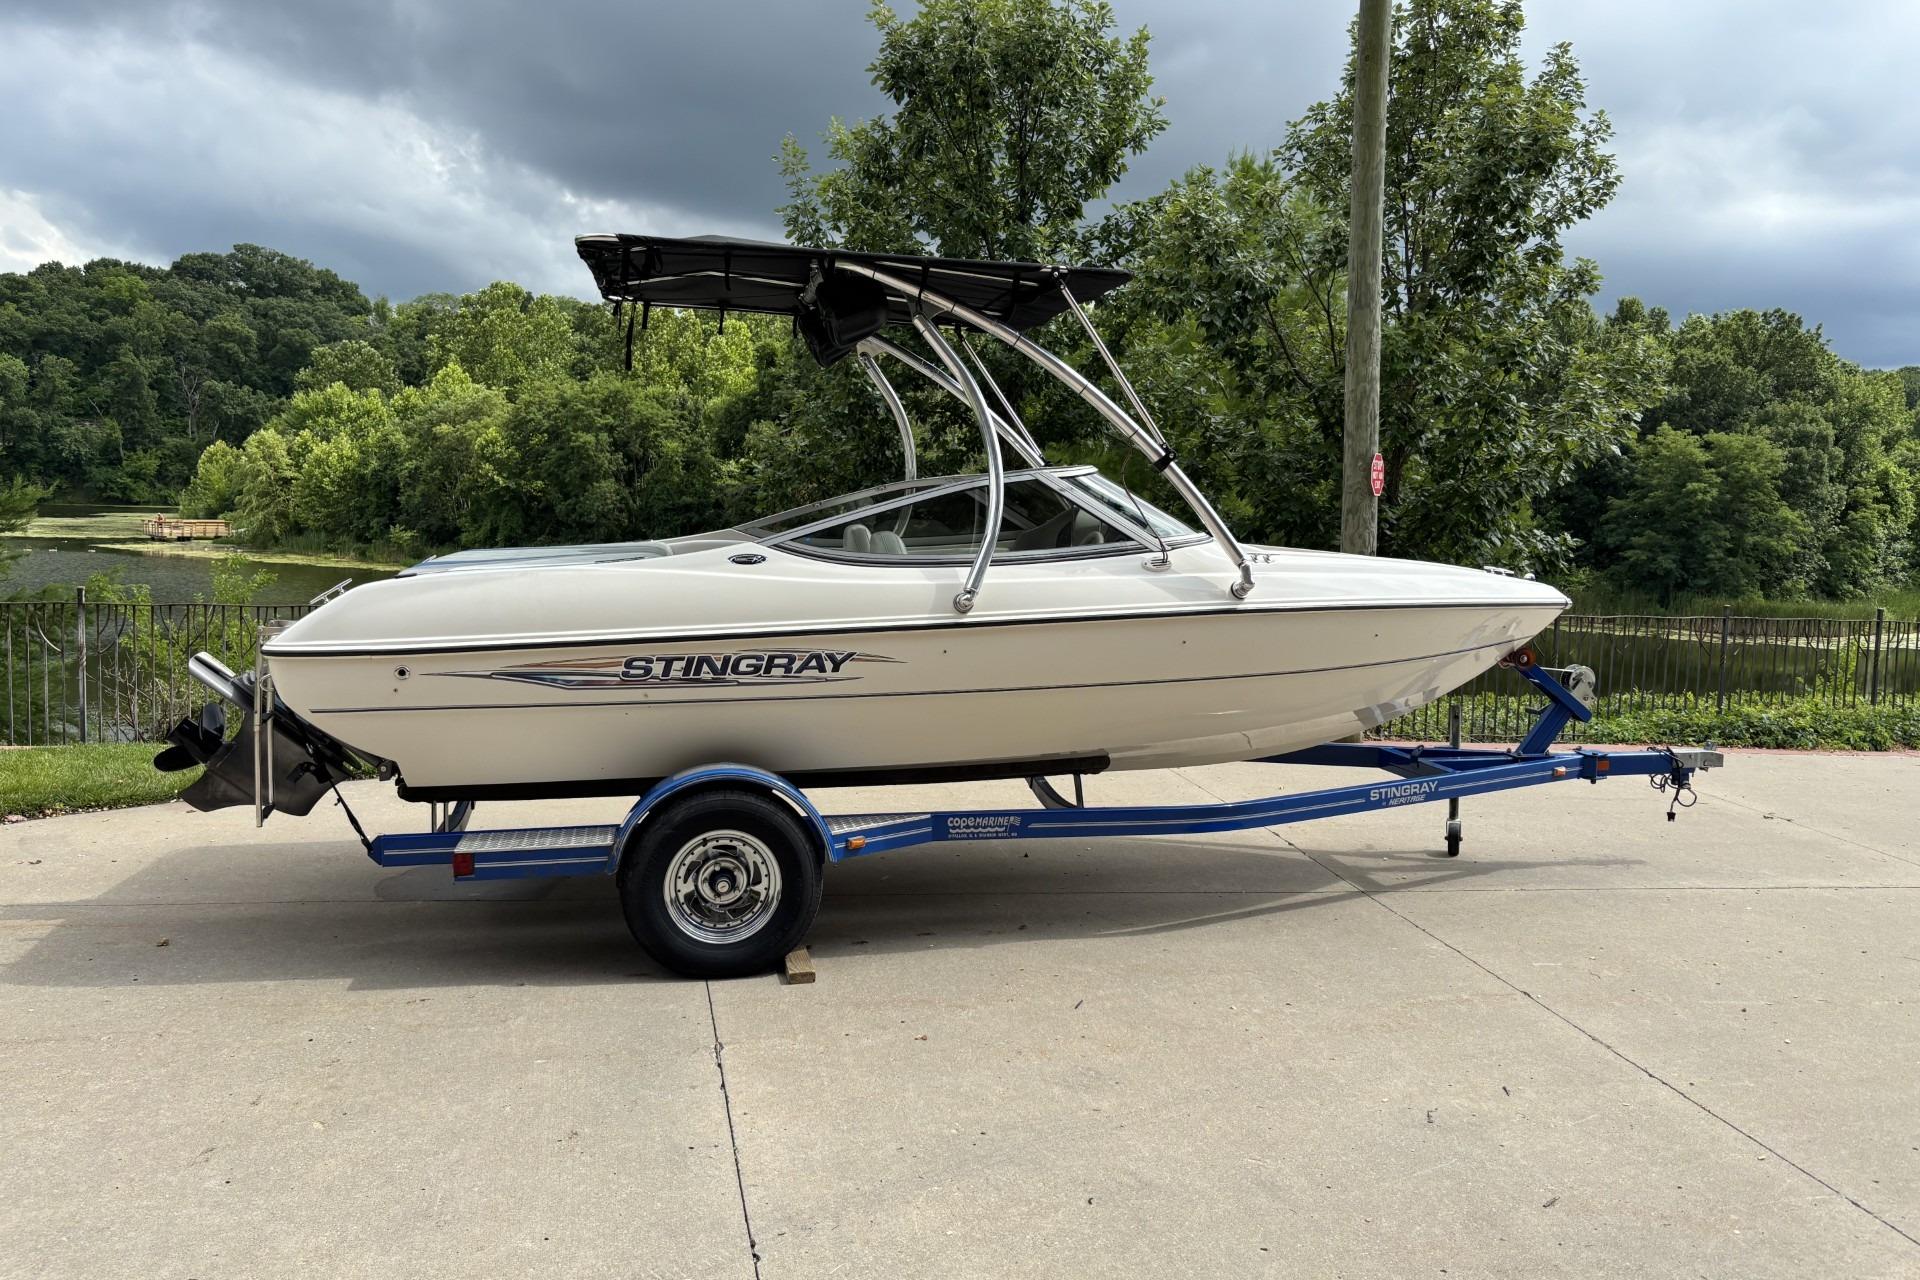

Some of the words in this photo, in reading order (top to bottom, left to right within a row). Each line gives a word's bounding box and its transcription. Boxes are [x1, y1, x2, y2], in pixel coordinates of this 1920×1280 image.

[620, 652, 858, 681] STINGRAY
[1370, 780, 1438, 801] STINGRAY
[1389, 794, 1426, 806] HERITAGE
